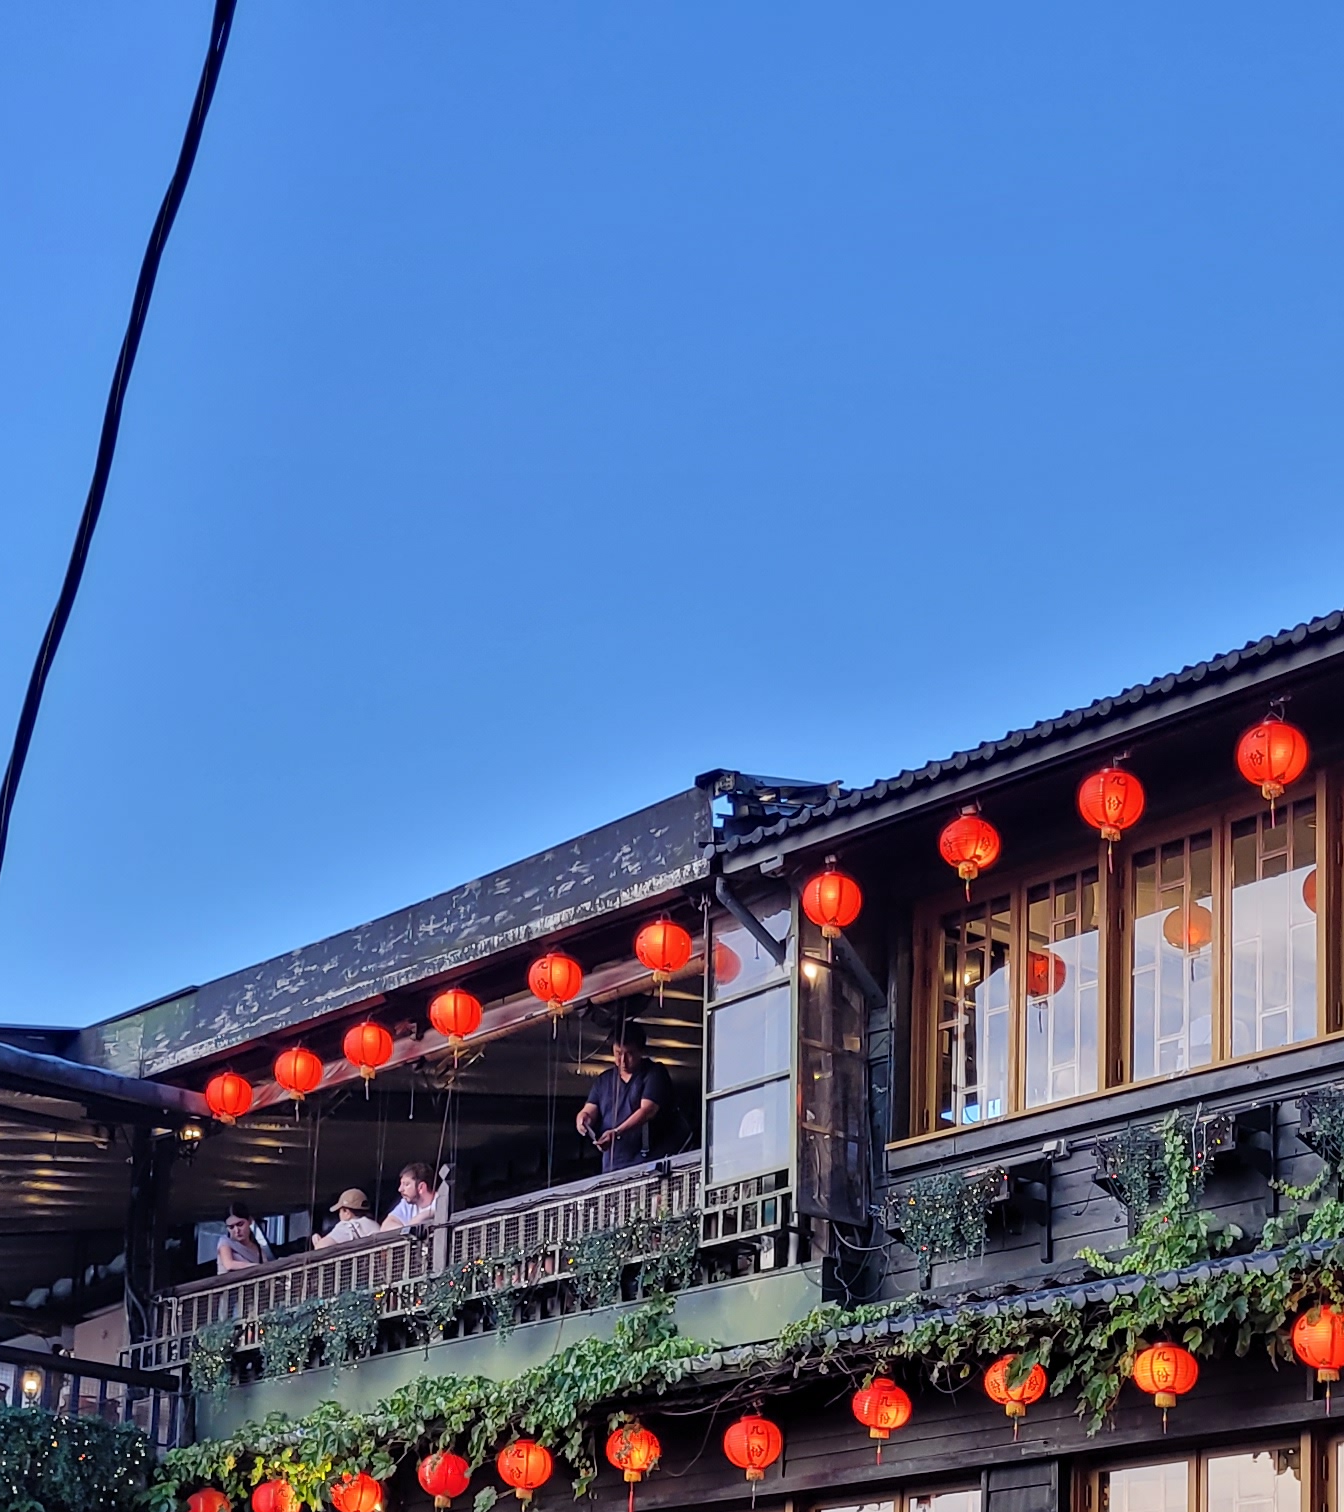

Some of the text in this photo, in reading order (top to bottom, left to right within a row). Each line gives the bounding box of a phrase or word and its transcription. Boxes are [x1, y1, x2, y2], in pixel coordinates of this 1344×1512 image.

[1156, 1350, 1171, 1384] 九份
[879, 1395, 892, 1426] 九份
[751, 1425, 765, 1458] 九份
